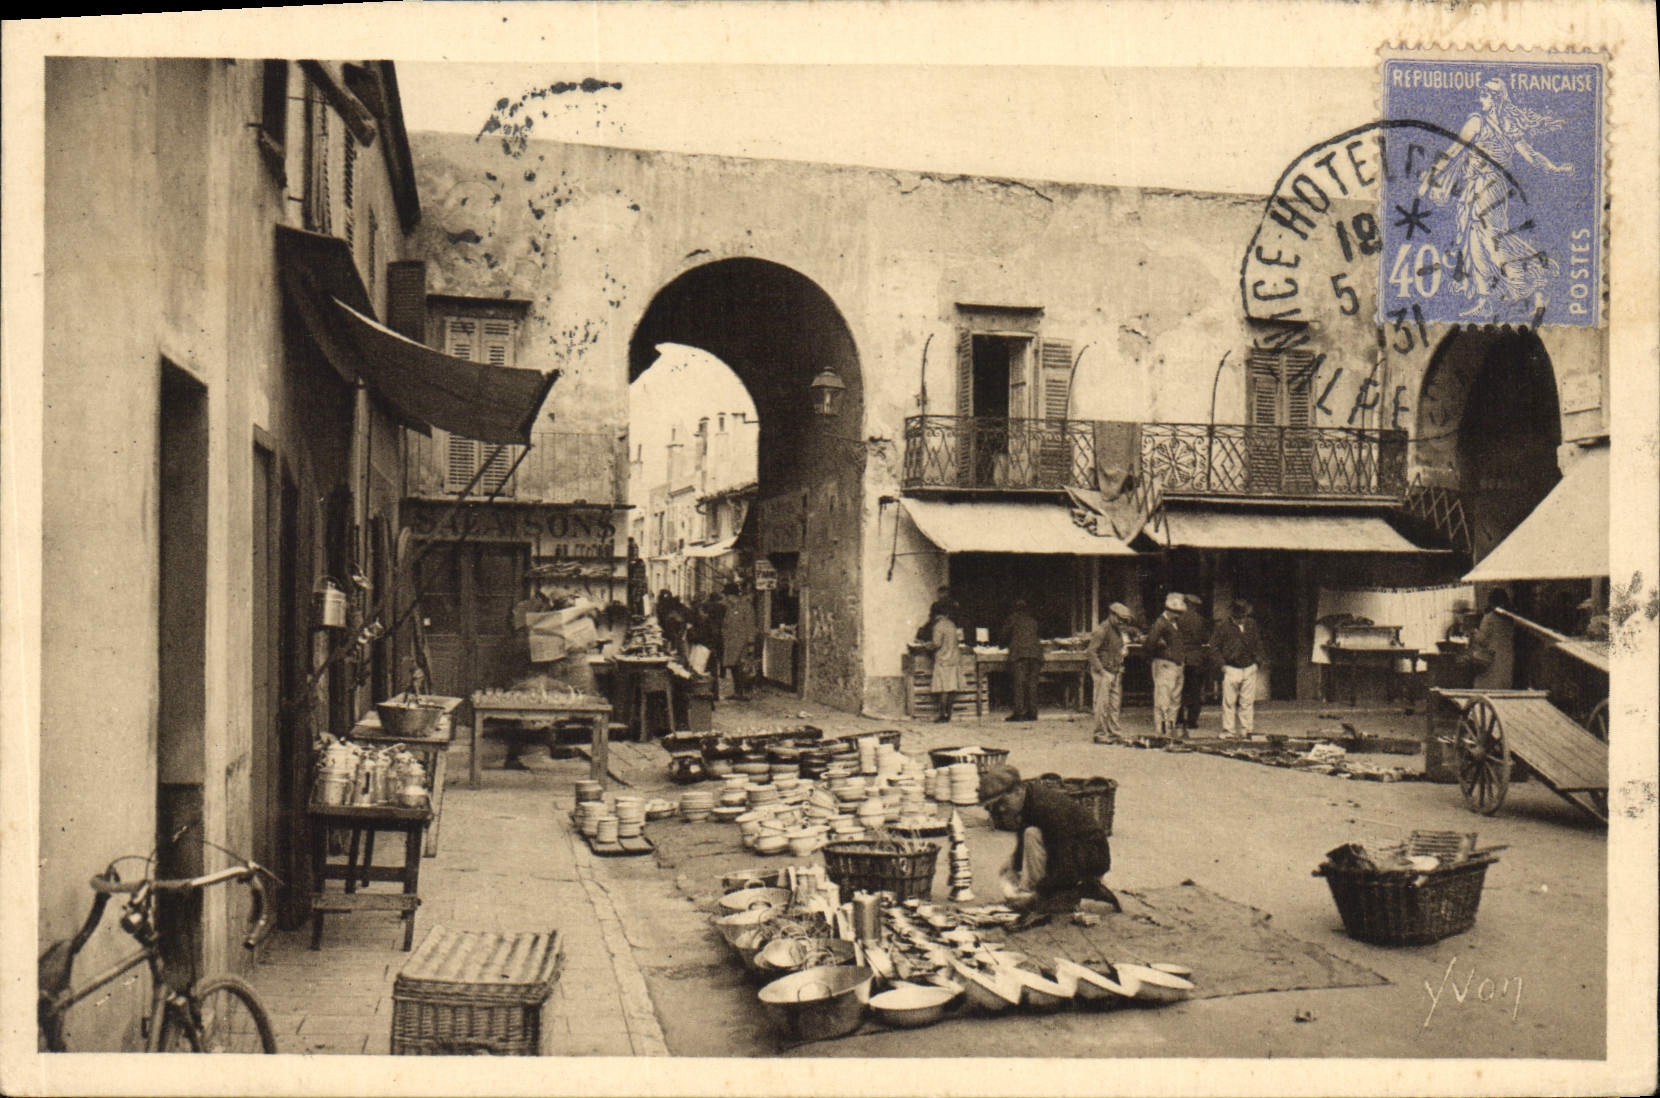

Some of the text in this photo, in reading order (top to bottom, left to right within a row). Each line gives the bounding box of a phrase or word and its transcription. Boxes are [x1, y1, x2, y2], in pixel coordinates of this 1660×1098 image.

[1393, 69, 1593, 93] REPUBLIQUE FRANÇAISE
[1270, 135, 1397, 242] HOTEL
[1569, 228, 1591, 314] POSTES
